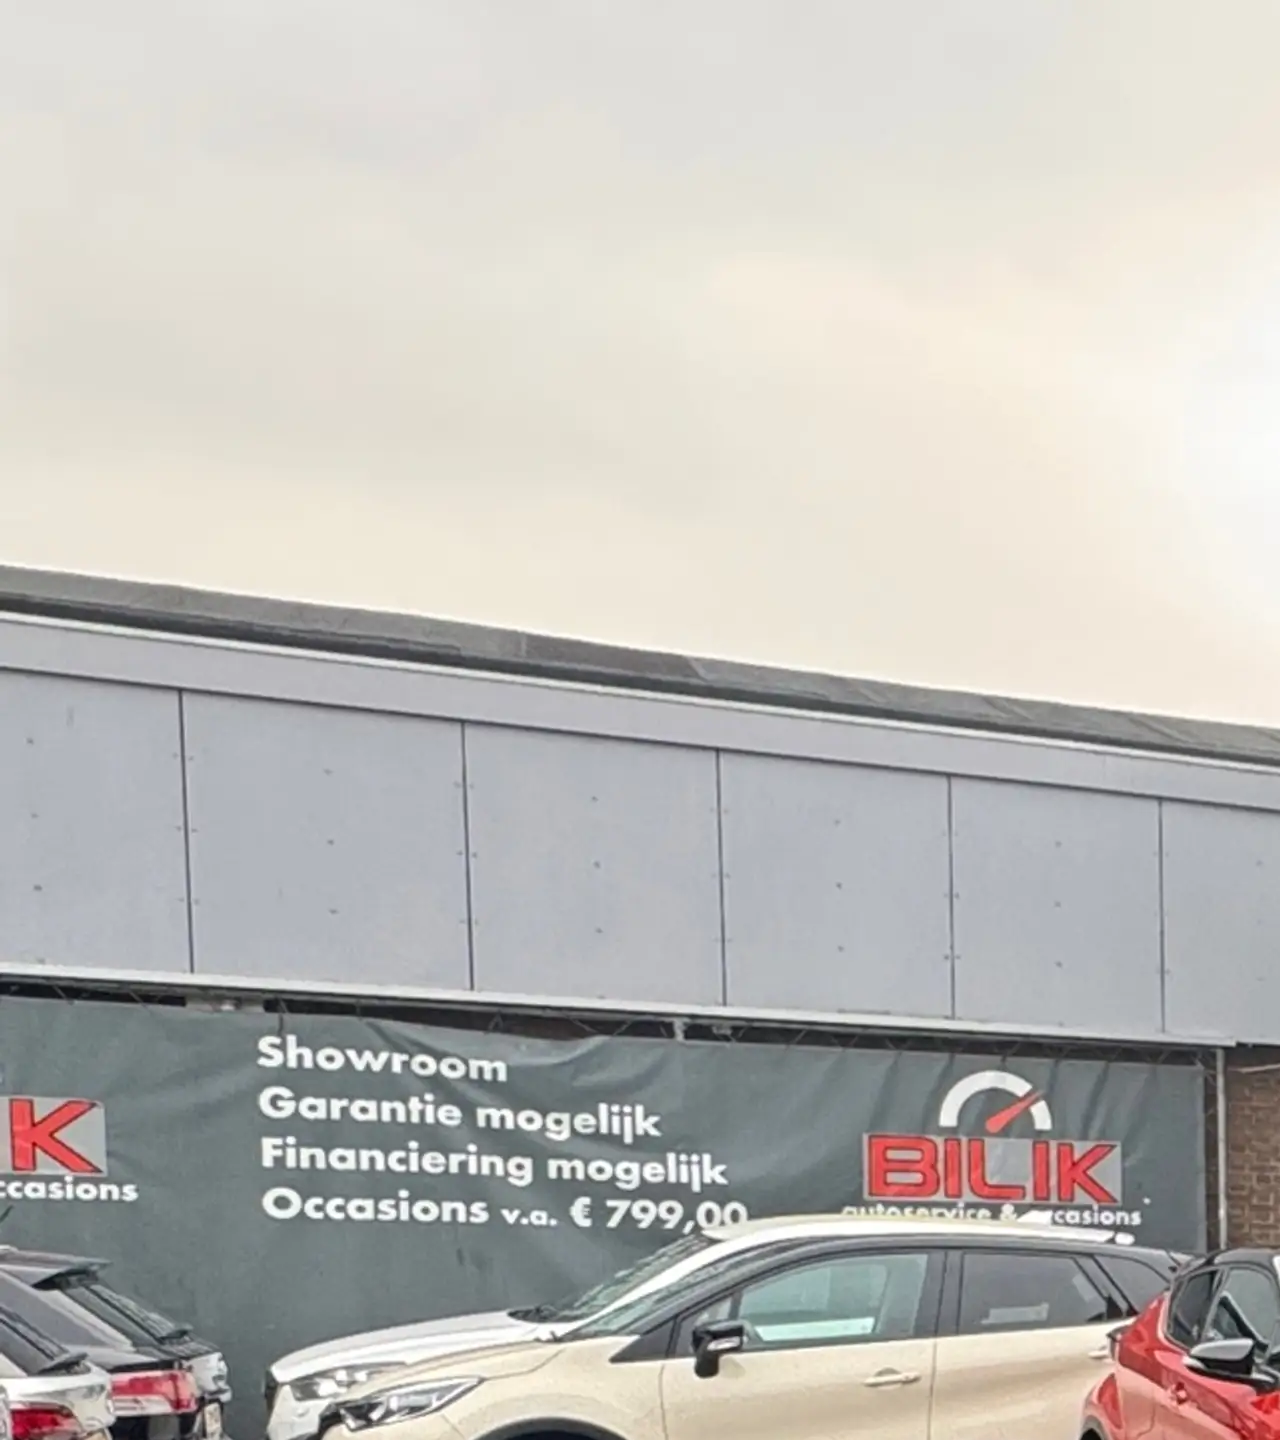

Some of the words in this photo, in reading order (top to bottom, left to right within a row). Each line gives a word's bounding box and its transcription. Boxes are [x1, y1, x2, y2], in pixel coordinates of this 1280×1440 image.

[257, 1034, 508, 1082] Showroom
[258, 1085, 463, 1127] Garantie
[476, 1102, 662, 1145] mogelijk
[260, 1136, 534, 1187] Financiering
[547, 1152, 729, 1193] mogelijk
[867, 1134, 1118, 1204] BILIK
[262, 1186, 489, 1224] Occasions
[500, 1207, 558, 1226] v.a.
[570, 1196, 593, 1228] €
[605, 1199, 749, 1234] 799,00
